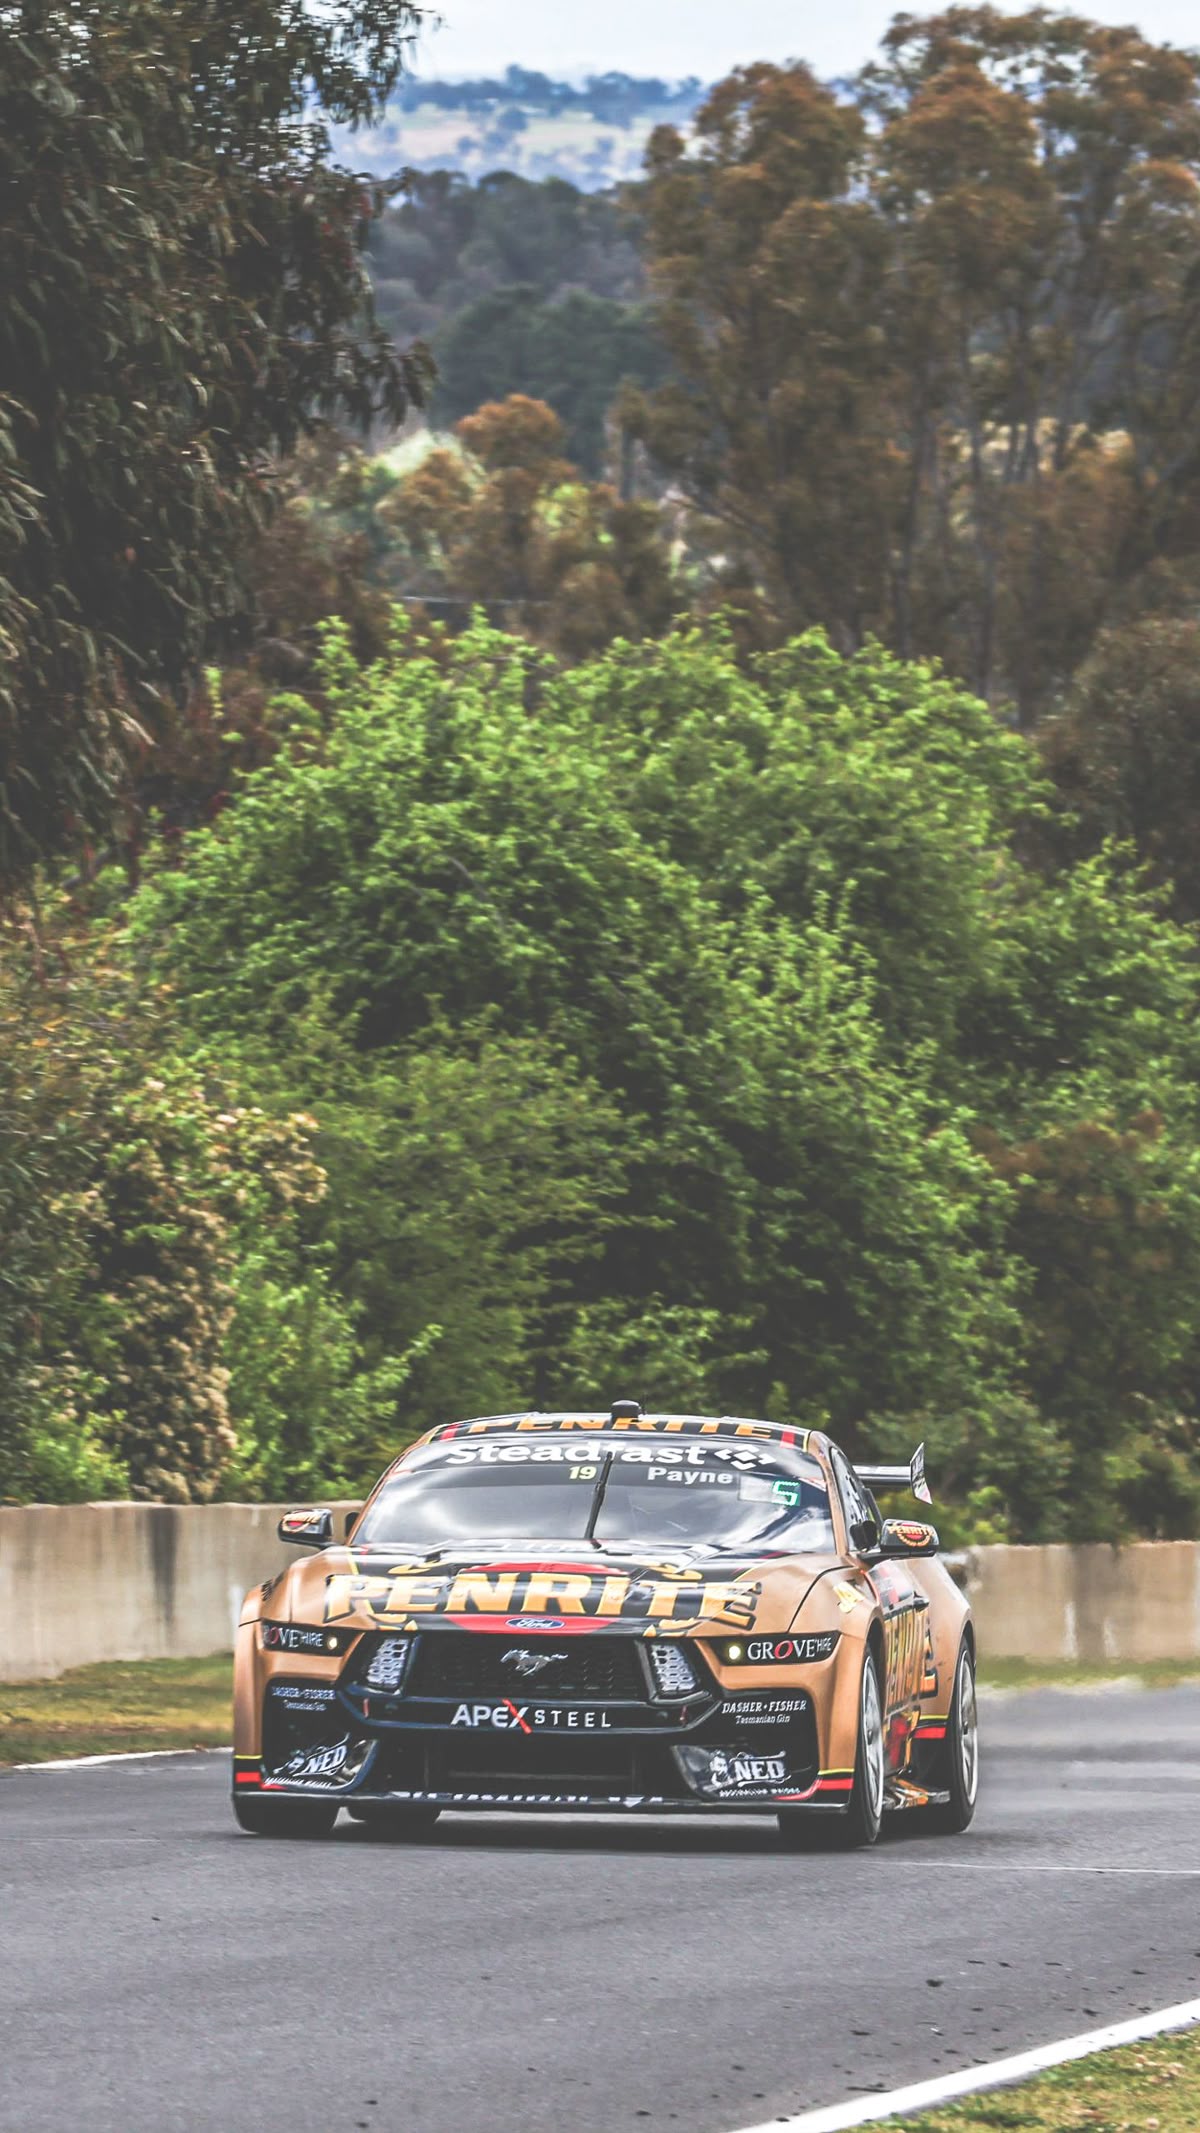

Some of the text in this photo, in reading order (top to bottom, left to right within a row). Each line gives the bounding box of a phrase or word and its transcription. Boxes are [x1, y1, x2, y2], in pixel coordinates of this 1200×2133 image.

[446, 1441, 706, 1465] Steadfast
[569, 1466, 597, 1480] 19
[647, 1467, 733, 1485] Payne
[324, 1571, 761, 1630] PENRITE
[747, 1640, 815, 1660] GROVE
[451, 1699, 612, 1735] APEX STEEL
[722, 1700, 807, 1714] DASHER FISHER
[303, 1745, 347, 1773] NED
[734, 1760, 785, 1781] NED
